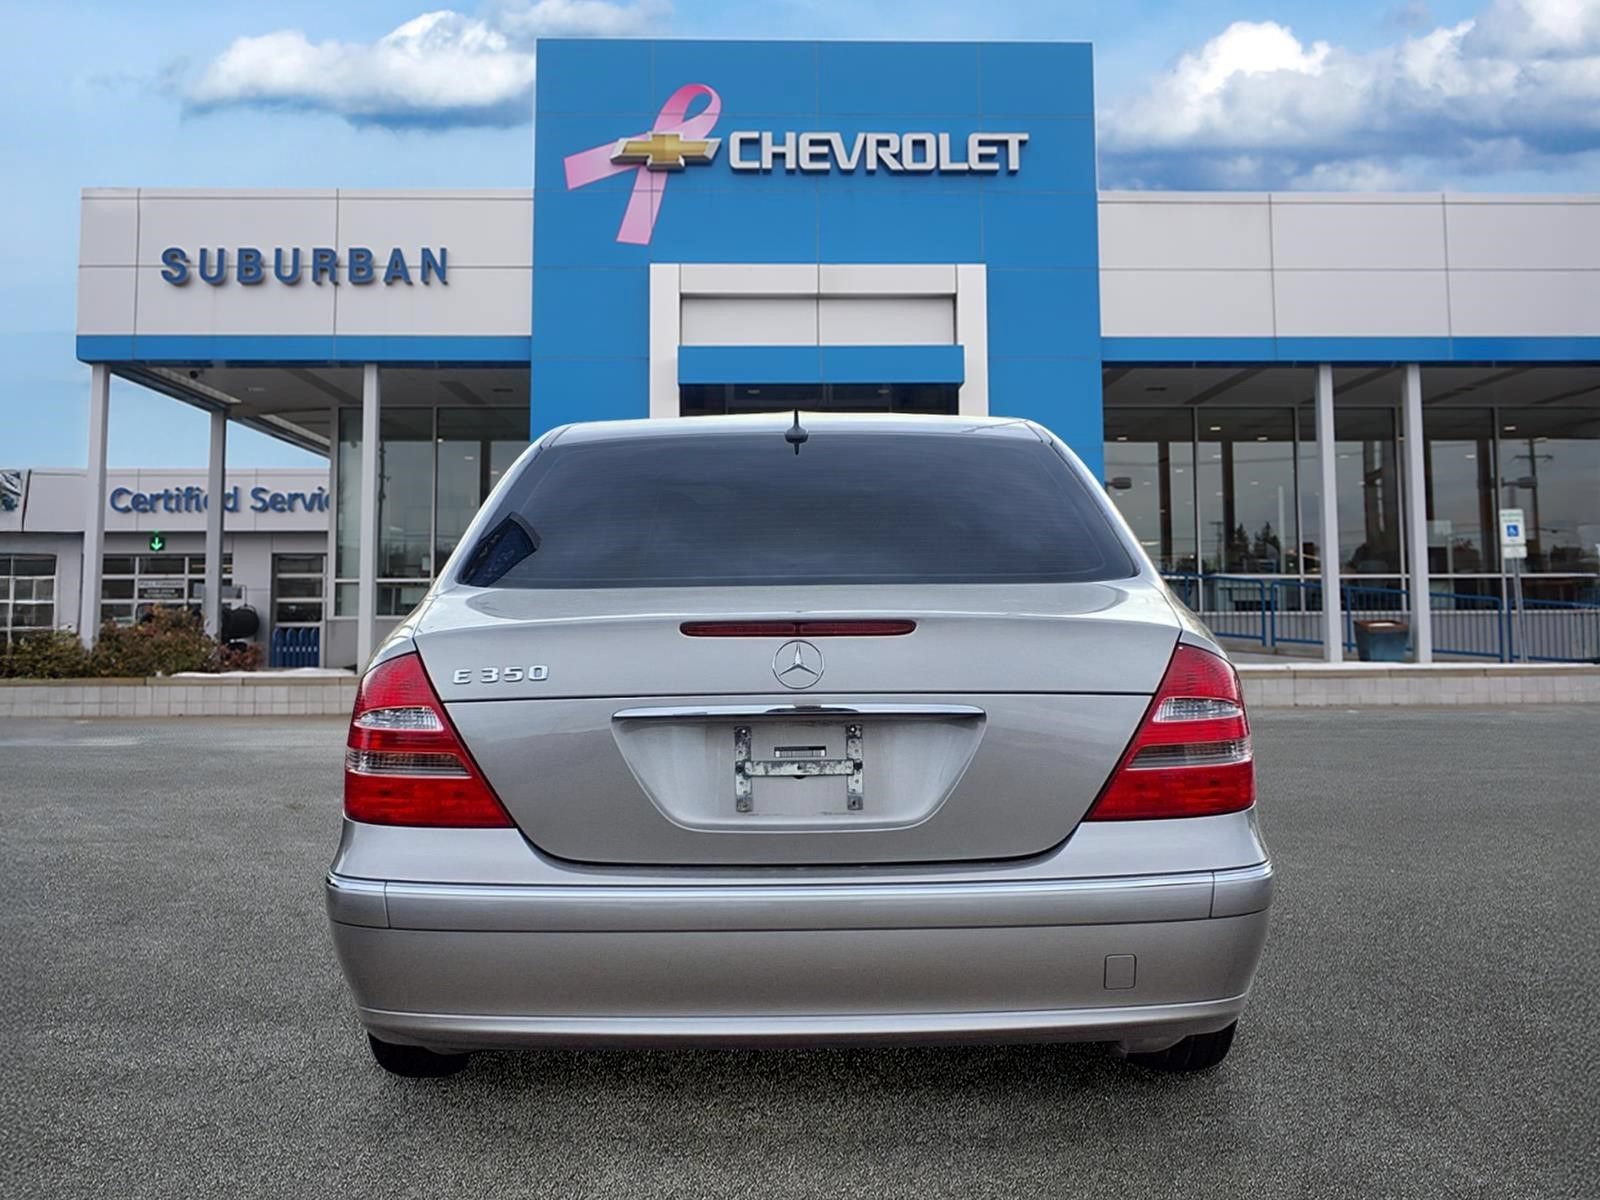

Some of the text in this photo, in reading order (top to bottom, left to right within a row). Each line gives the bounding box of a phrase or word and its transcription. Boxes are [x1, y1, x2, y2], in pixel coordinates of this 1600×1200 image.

[729, 131, 1029, 173] CHEVROLET
[160, 247, 449, 286] SUBURBAN
[453, 665, 549, 685] E 350
